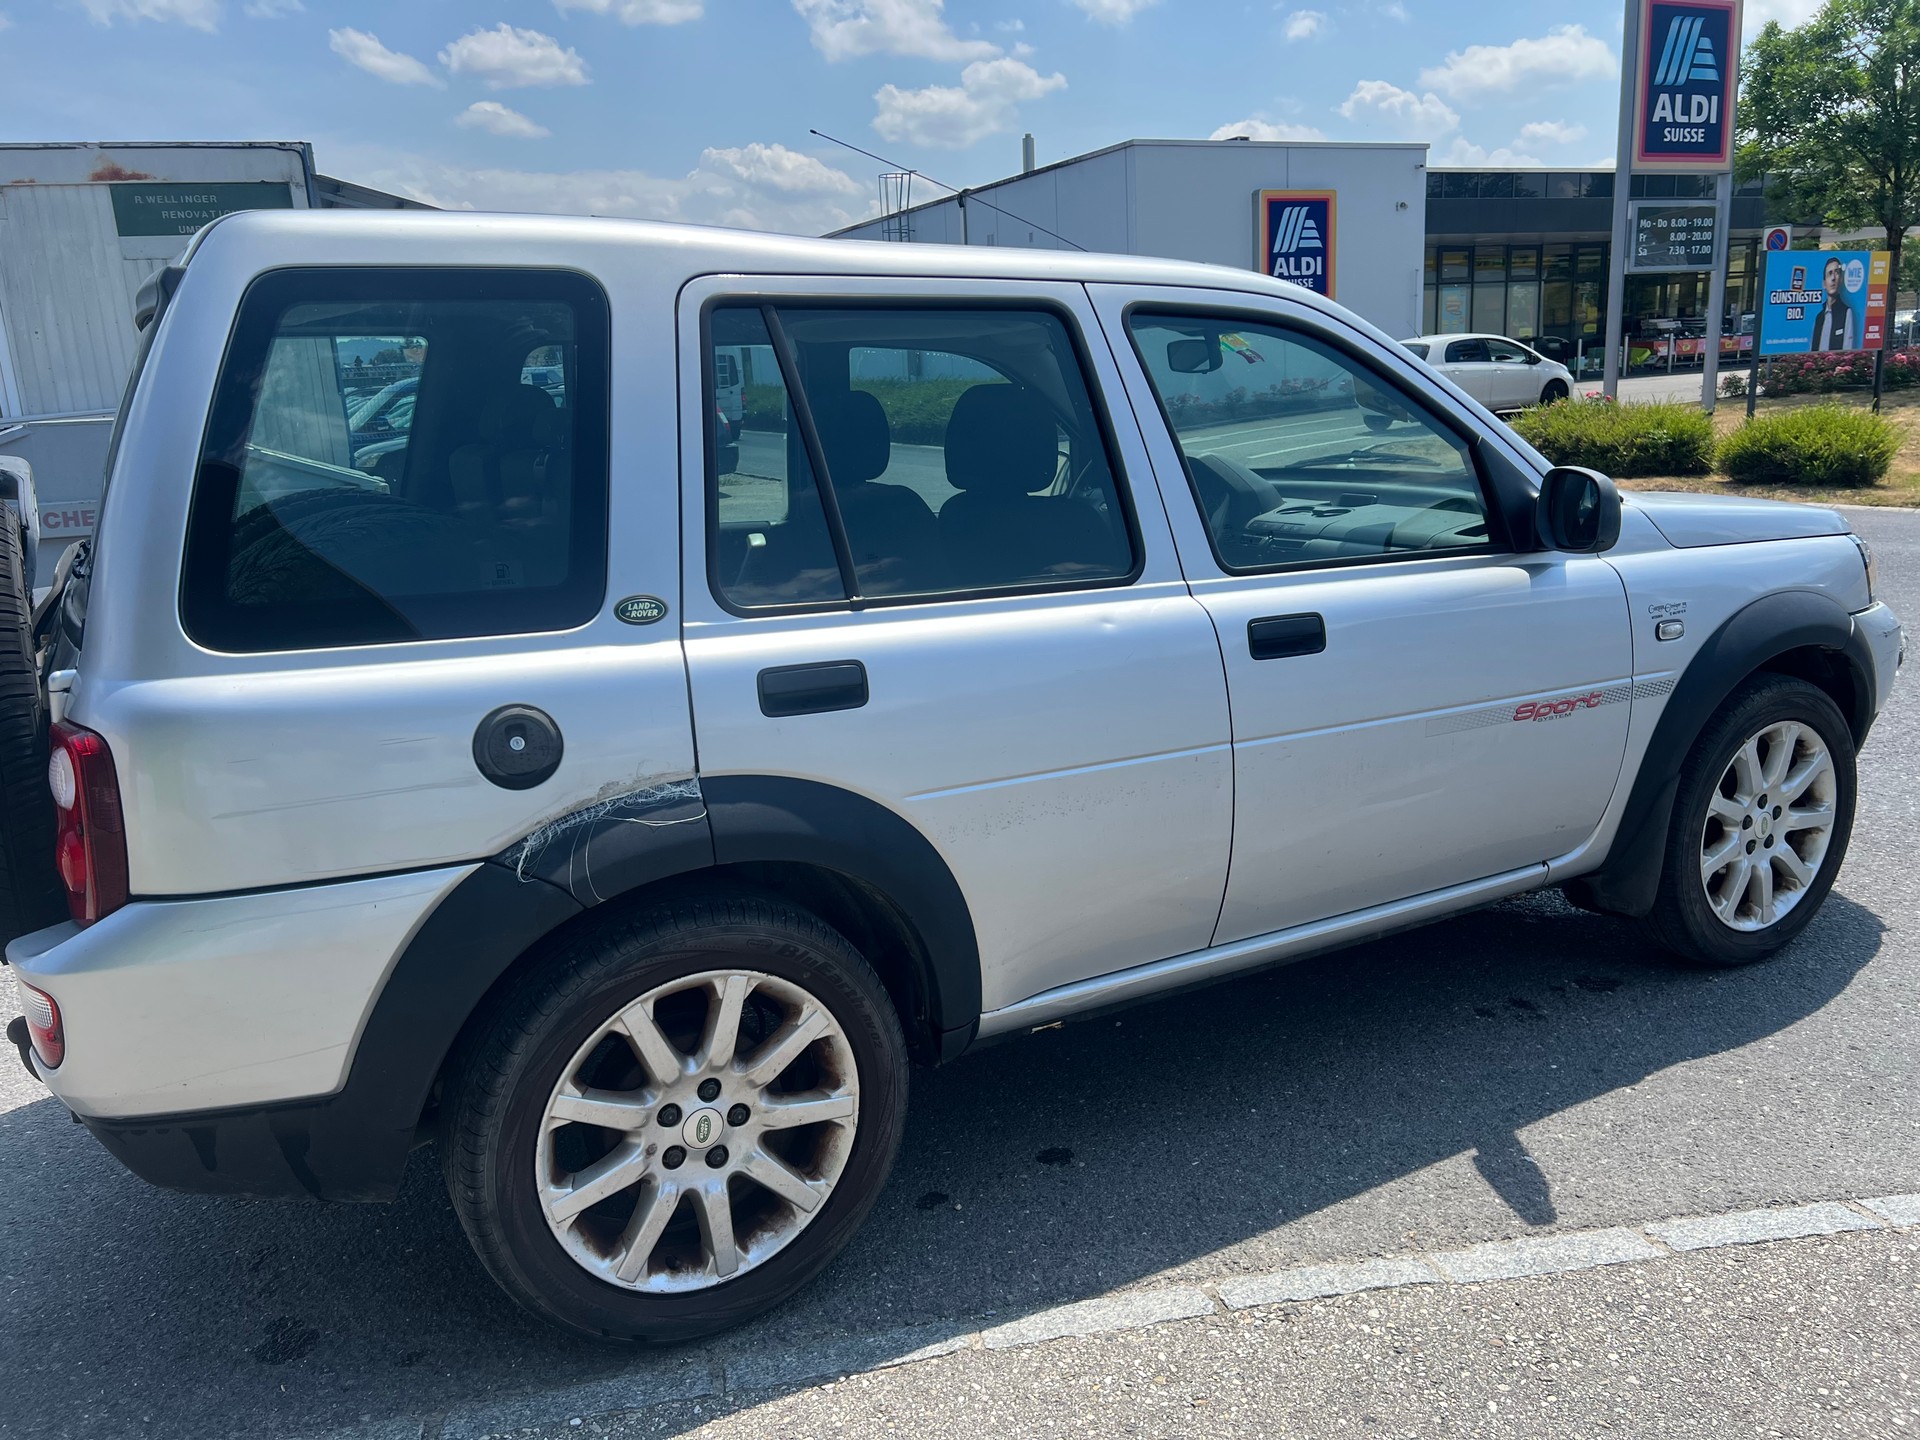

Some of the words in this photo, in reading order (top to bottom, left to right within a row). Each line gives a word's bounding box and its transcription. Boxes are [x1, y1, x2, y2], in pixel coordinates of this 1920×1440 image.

[1652, 93, 1718, 124] ALDI
[1663, 127, 1705, 142] SUISSE
[146, 195, 217, 204] WELLINGER
[1640, 219, 1651, 228] Mo
[1657, 218, 1668, 228] Do
[1670, 218, 1687, 228] 8.00
[1693, 218, 1713, 227] 19.00
[1639, 233, 1647, 242] Fr
[1669, 232, 1686, 241] 8.00
[1692, 231, 1712, 240] 20.00
[1638, 247, 1648, 256] Sa
[1668, 246, 1685, 255] 7.30
[1691, 245, 1711, 255] 17.00
[1273, 256, 1322, 276] ALDI
[1285, 278, 1313, 288] UISSE
[1770, 289, 1822, 303] GÜNSTIGSTES
[1787, 308, 1803, 319] BIO.
[628, 602, 650, 610] LAND
[631, 609, 658, 617] ROVER
[1513, 692, 1602, 721] Sport
[1537, 712, 1572, 722] SYSTEM
